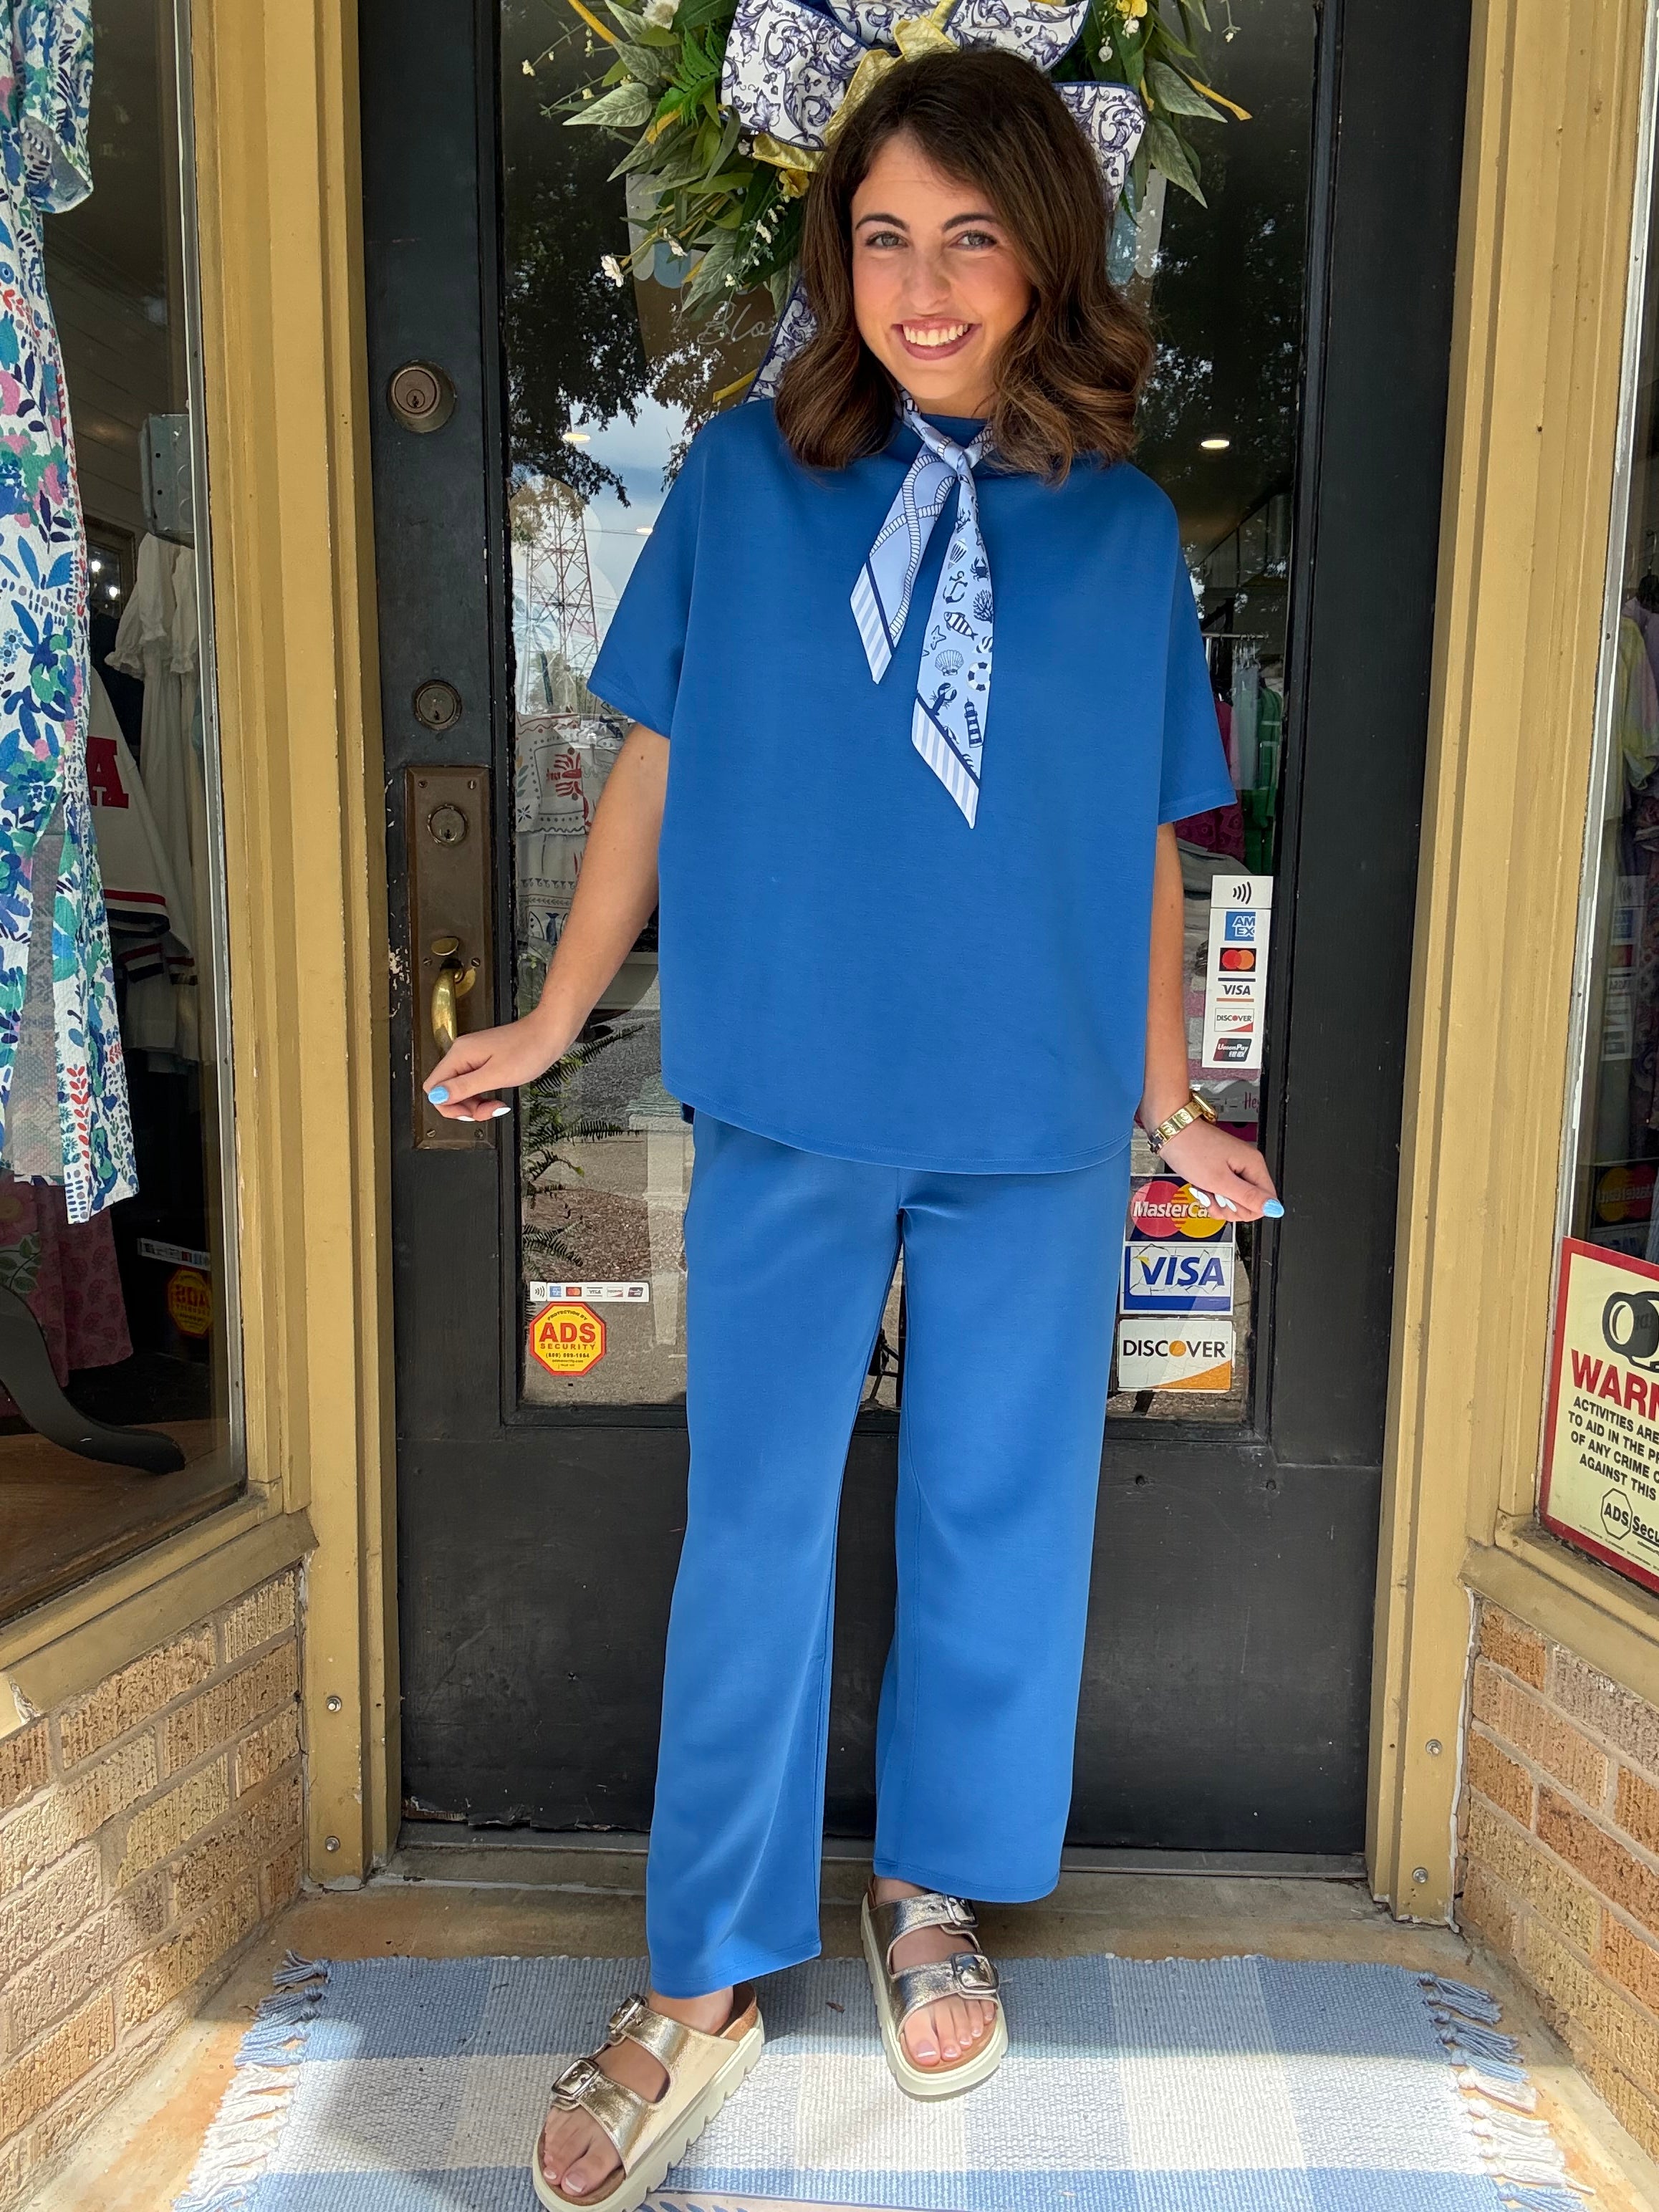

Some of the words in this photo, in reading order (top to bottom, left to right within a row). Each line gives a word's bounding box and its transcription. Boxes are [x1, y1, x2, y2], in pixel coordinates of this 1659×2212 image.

[85, 736, 129, 809] A
[1233, 916, 1256, 926] AM
[1221, 984, 1251, 996] VISA
[1133, 1201, 1211, 1218] MasterCa
[1138, 1256, 1226, 1287] VISA
[539, 1322, 596, 1343] ADS
[1122, 1340, 1227, 1359] DISCOVER
[1568, 1410, 1583, 1427] TO
[1585, 1419, 1605, 1437] AID
[1608, 1429, 1620, 1445] IN
[1622, 1436, 1645, 1457] THE
[1573, 1396, 1634, 1433] ACTIVITIES
[1636, 1424, 1659, 1446] ARE
[1571, 1430, 1586, 1446] OF
[1588, 1439, 1611, 1458] ANY
[1613, 1451, 1650, 1479] CRIME
[1579, 1453, 1627, 1486] AGAINST
[1630, 1477, 1657, 1501] THIS
[1604, 1503, 1629, 1527] ADS
[1632, 1515, 1659, 1543] Secu
